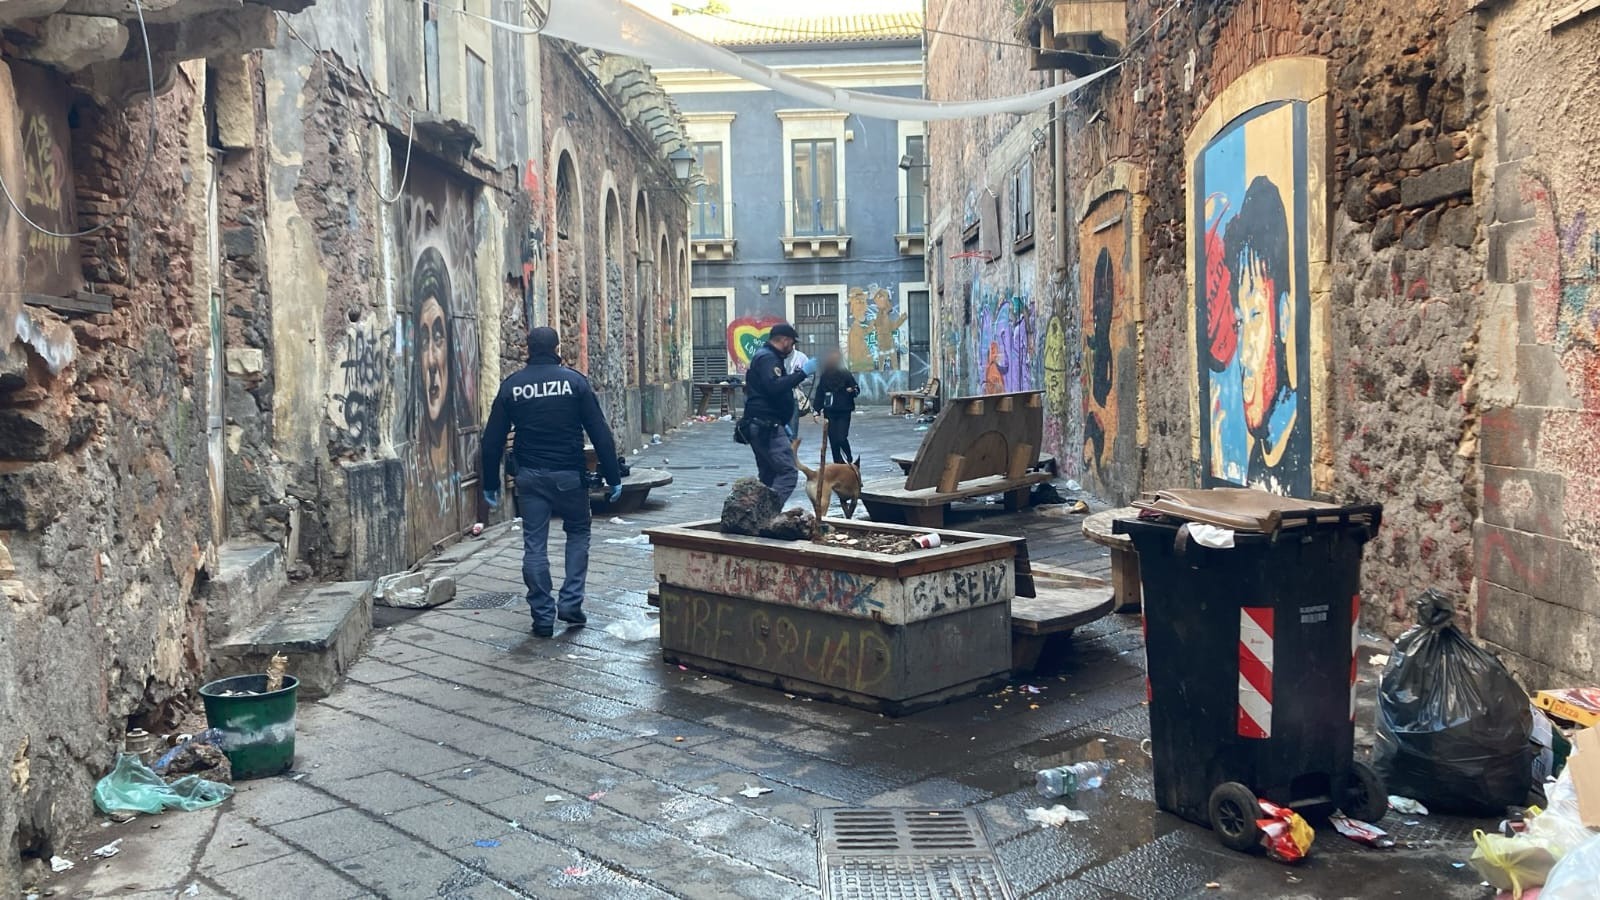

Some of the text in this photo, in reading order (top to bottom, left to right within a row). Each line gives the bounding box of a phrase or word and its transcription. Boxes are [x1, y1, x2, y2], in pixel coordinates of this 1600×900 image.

[512, 380, 573, 401] POLIZIA
[746, 606, 892, 691] SQUAD
[1554, 704, 1579, 718] pizza
